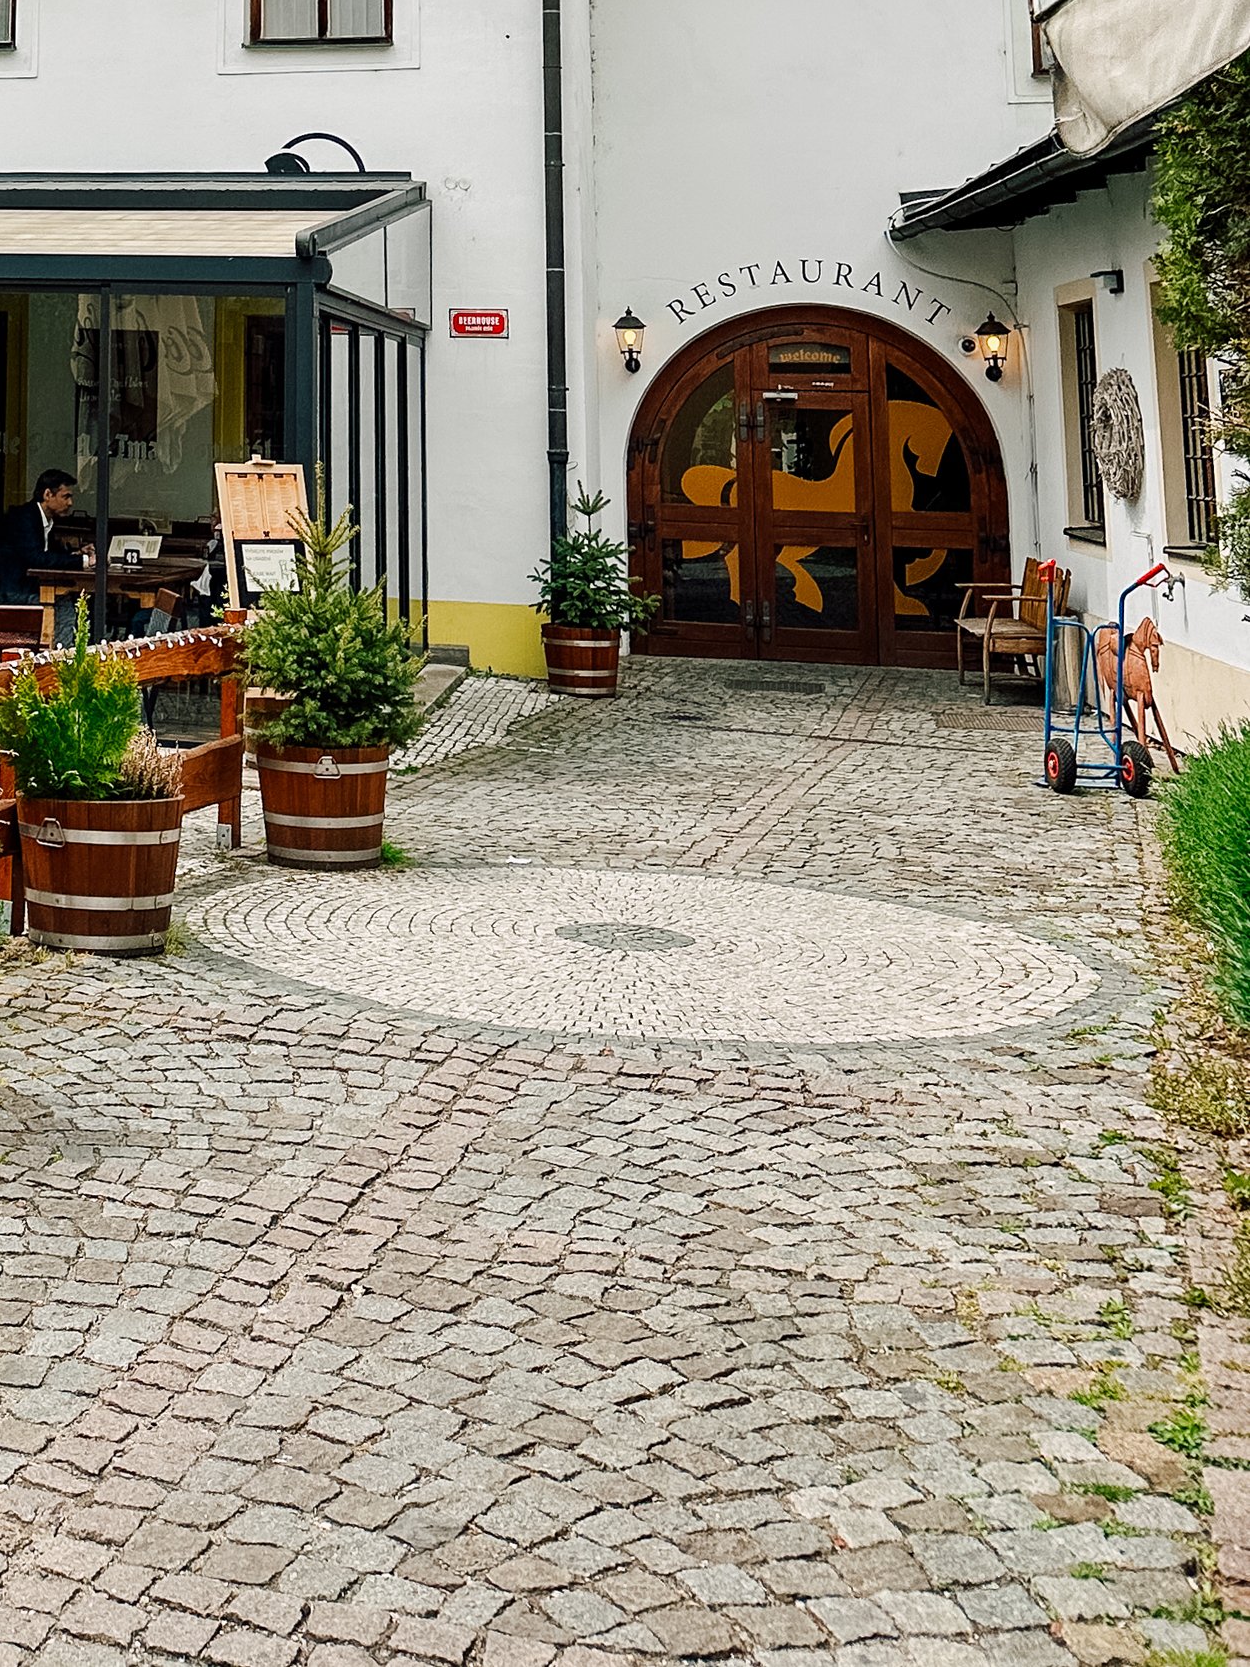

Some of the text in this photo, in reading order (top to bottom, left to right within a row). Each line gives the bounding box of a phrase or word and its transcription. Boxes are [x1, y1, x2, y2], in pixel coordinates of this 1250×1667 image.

[665, 259, 952, 326] RESTAURANT
[458, 316, 500, 326] BEERHOUSE
[779, 348, 842, 364] welcome
